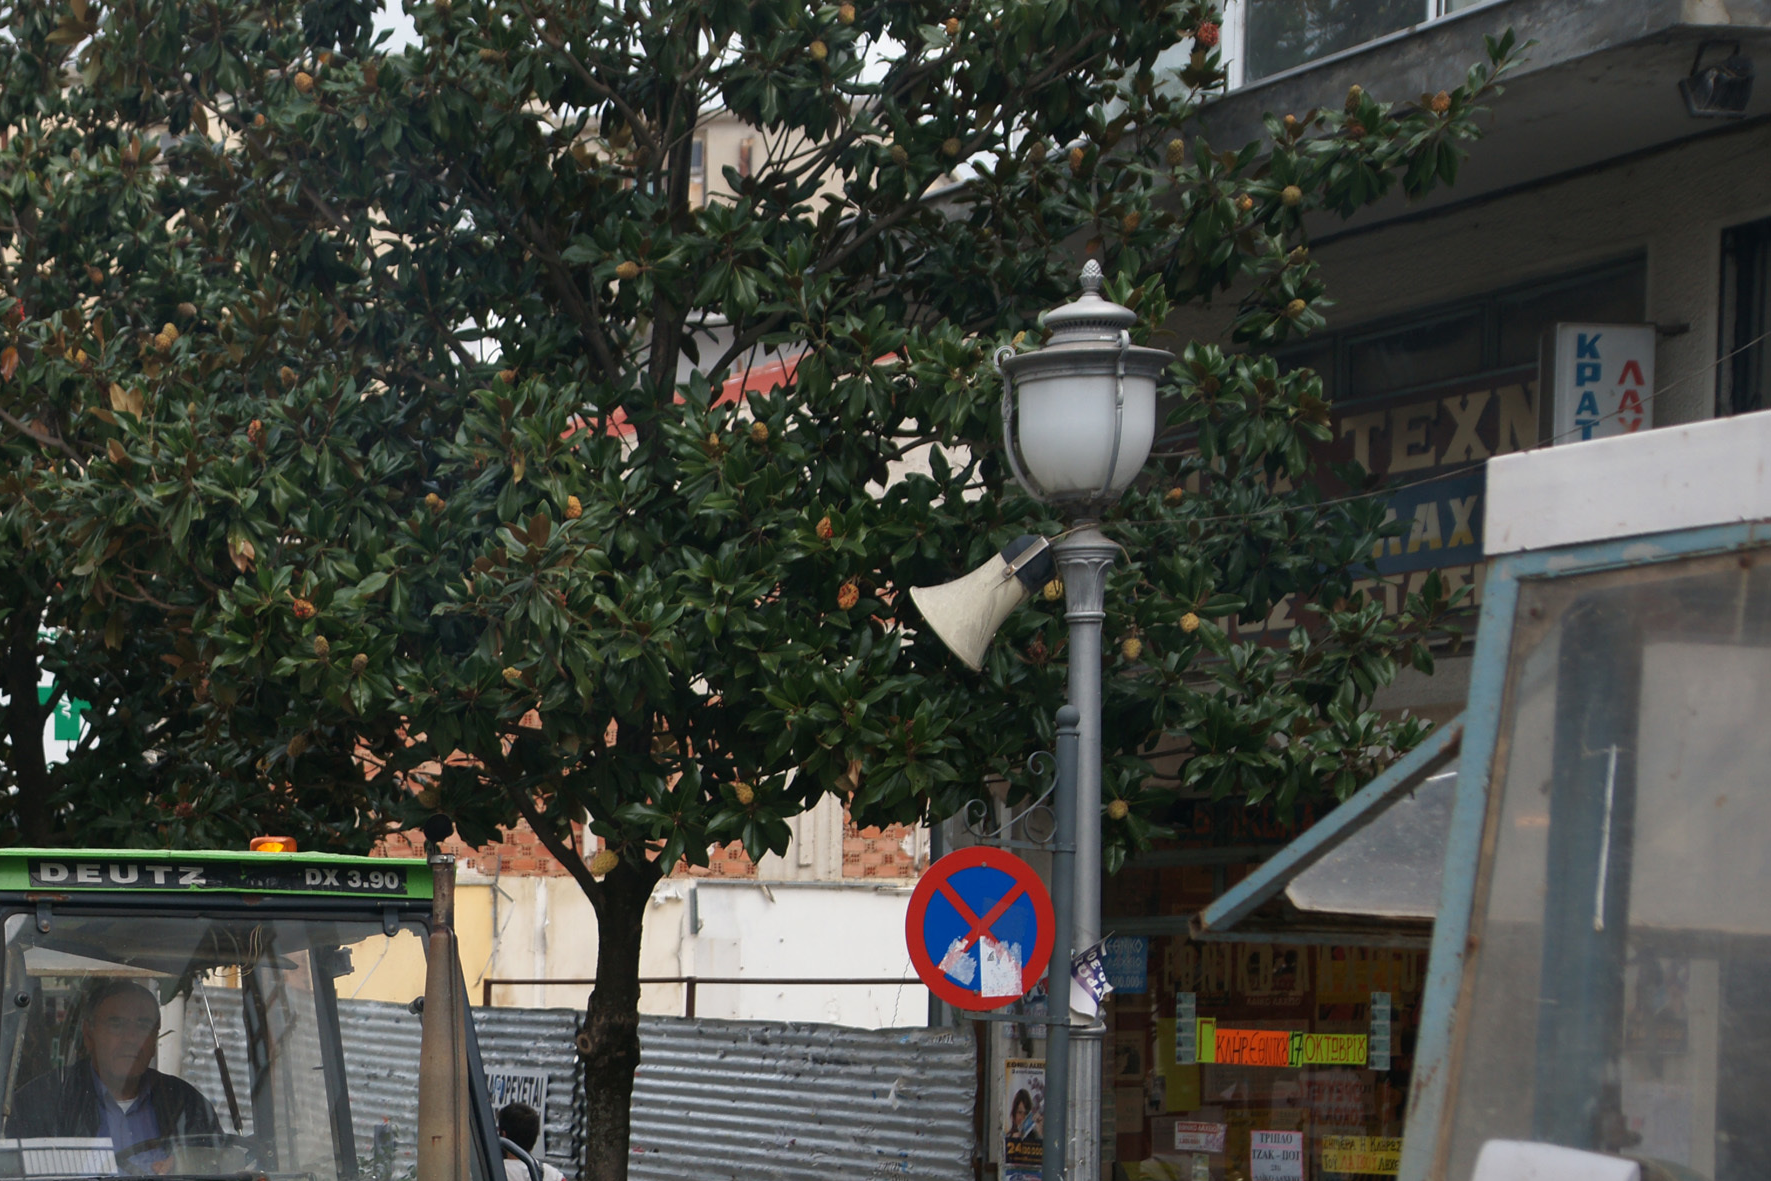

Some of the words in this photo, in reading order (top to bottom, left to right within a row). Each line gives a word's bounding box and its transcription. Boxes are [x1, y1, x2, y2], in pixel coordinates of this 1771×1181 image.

[39, 862, 206, 886] DEUTZ
[305, 868, 341, 888] DX
[347, 869, 399, 889] 3.90
[1289, 1032, 1303, 1066] 17
[1260, 1133, 1292, 1143] ΤΡΙΠΛΟ
